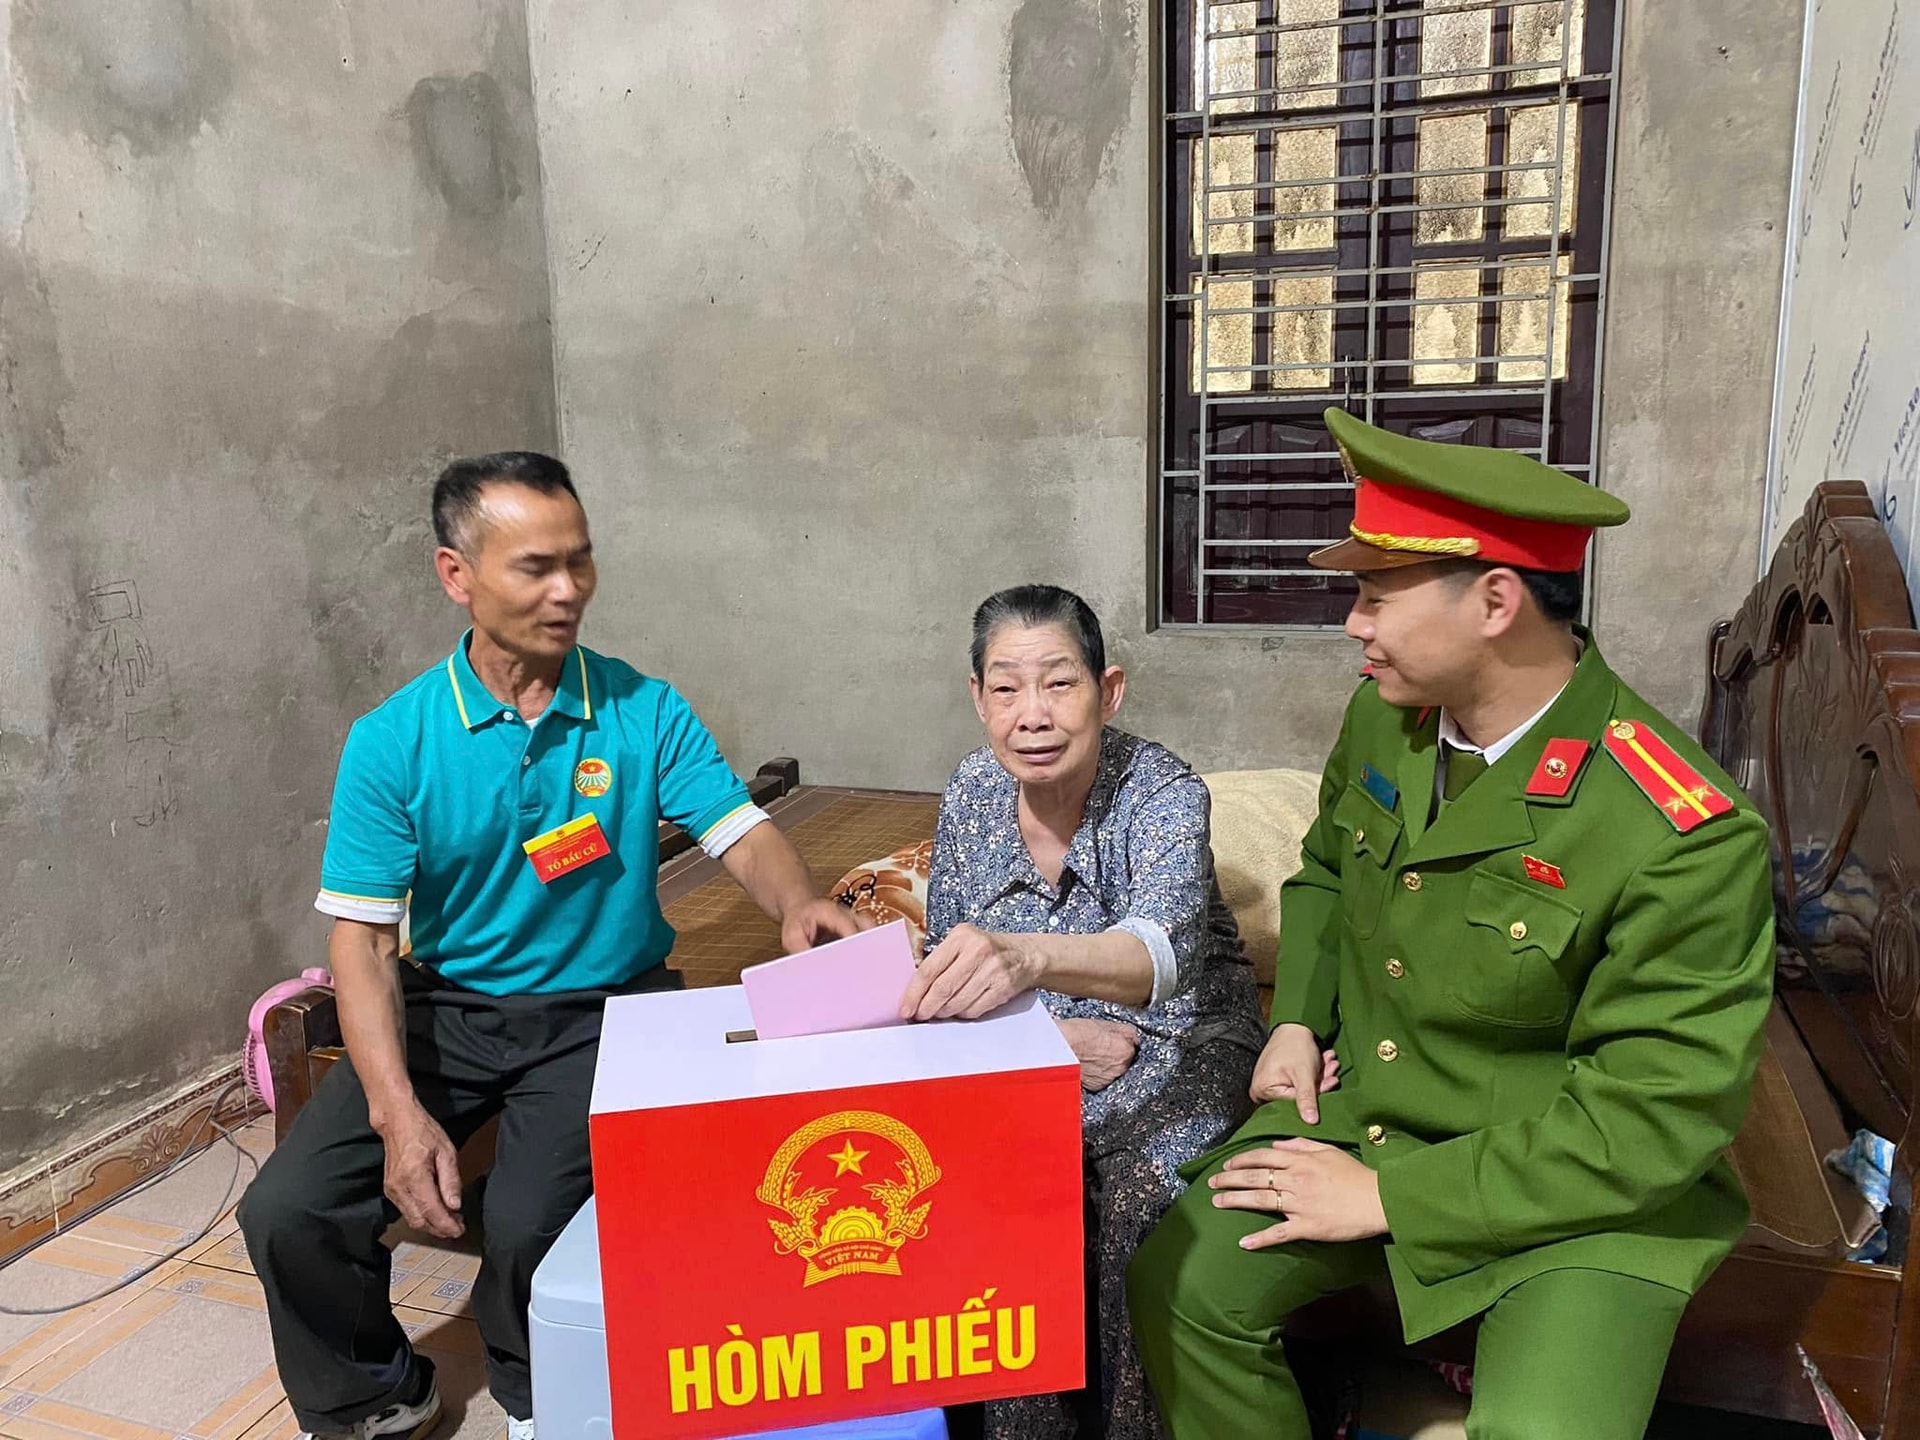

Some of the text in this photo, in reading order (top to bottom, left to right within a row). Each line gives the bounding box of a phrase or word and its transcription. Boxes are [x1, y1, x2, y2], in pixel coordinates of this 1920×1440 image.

[854, 1251, 879, 1260] NAM
[668, 1287, 1036, 1413] HÒM PHIẾU
